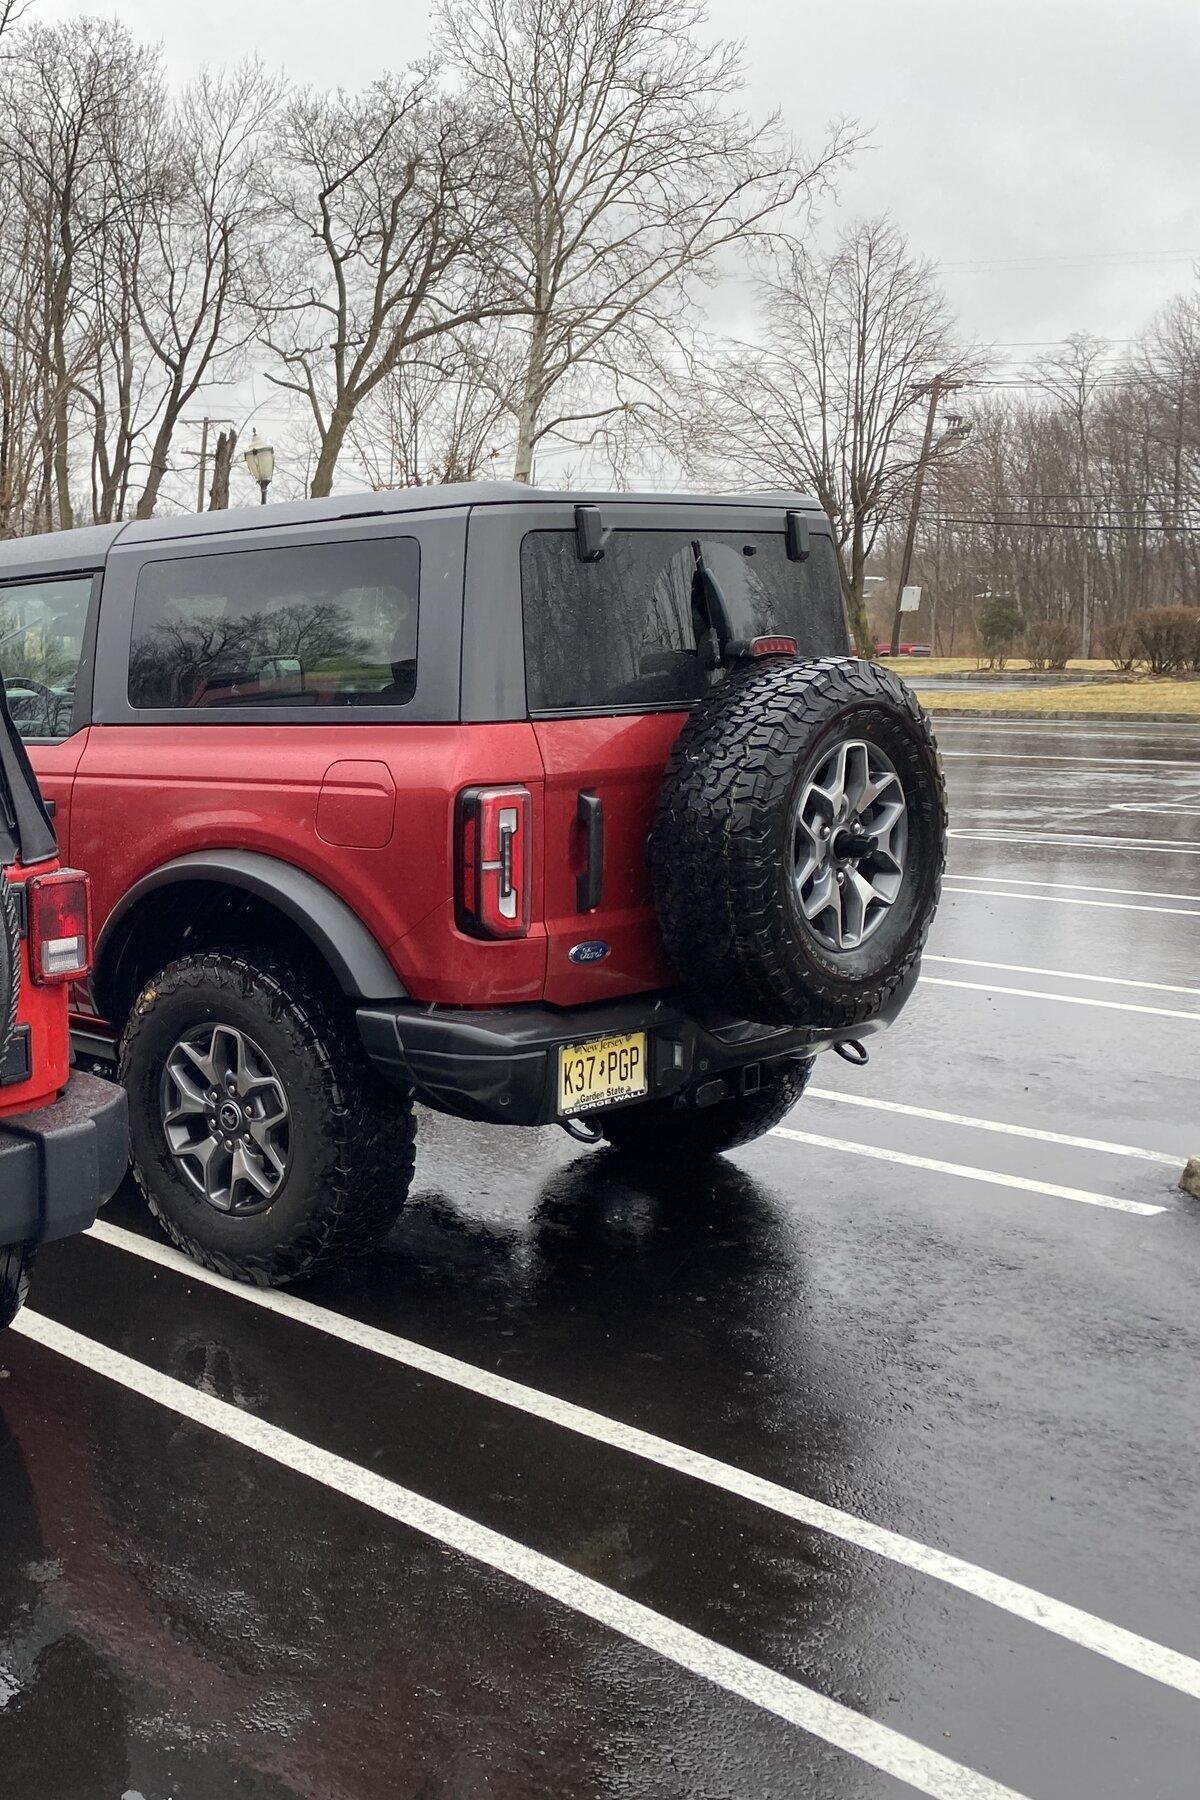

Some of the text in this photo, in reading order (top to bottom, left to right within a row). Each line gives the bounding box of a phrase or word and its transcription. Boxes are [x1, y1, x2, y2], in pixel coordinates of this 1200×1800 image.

[579, 1036, 625, 1055] New Jersey
[563, 1046, 639, 1096] K37 PGP
[564, 1089, 644, 1116] GEORGE WALL
[579, 1085, 625, 1104] Garden State
